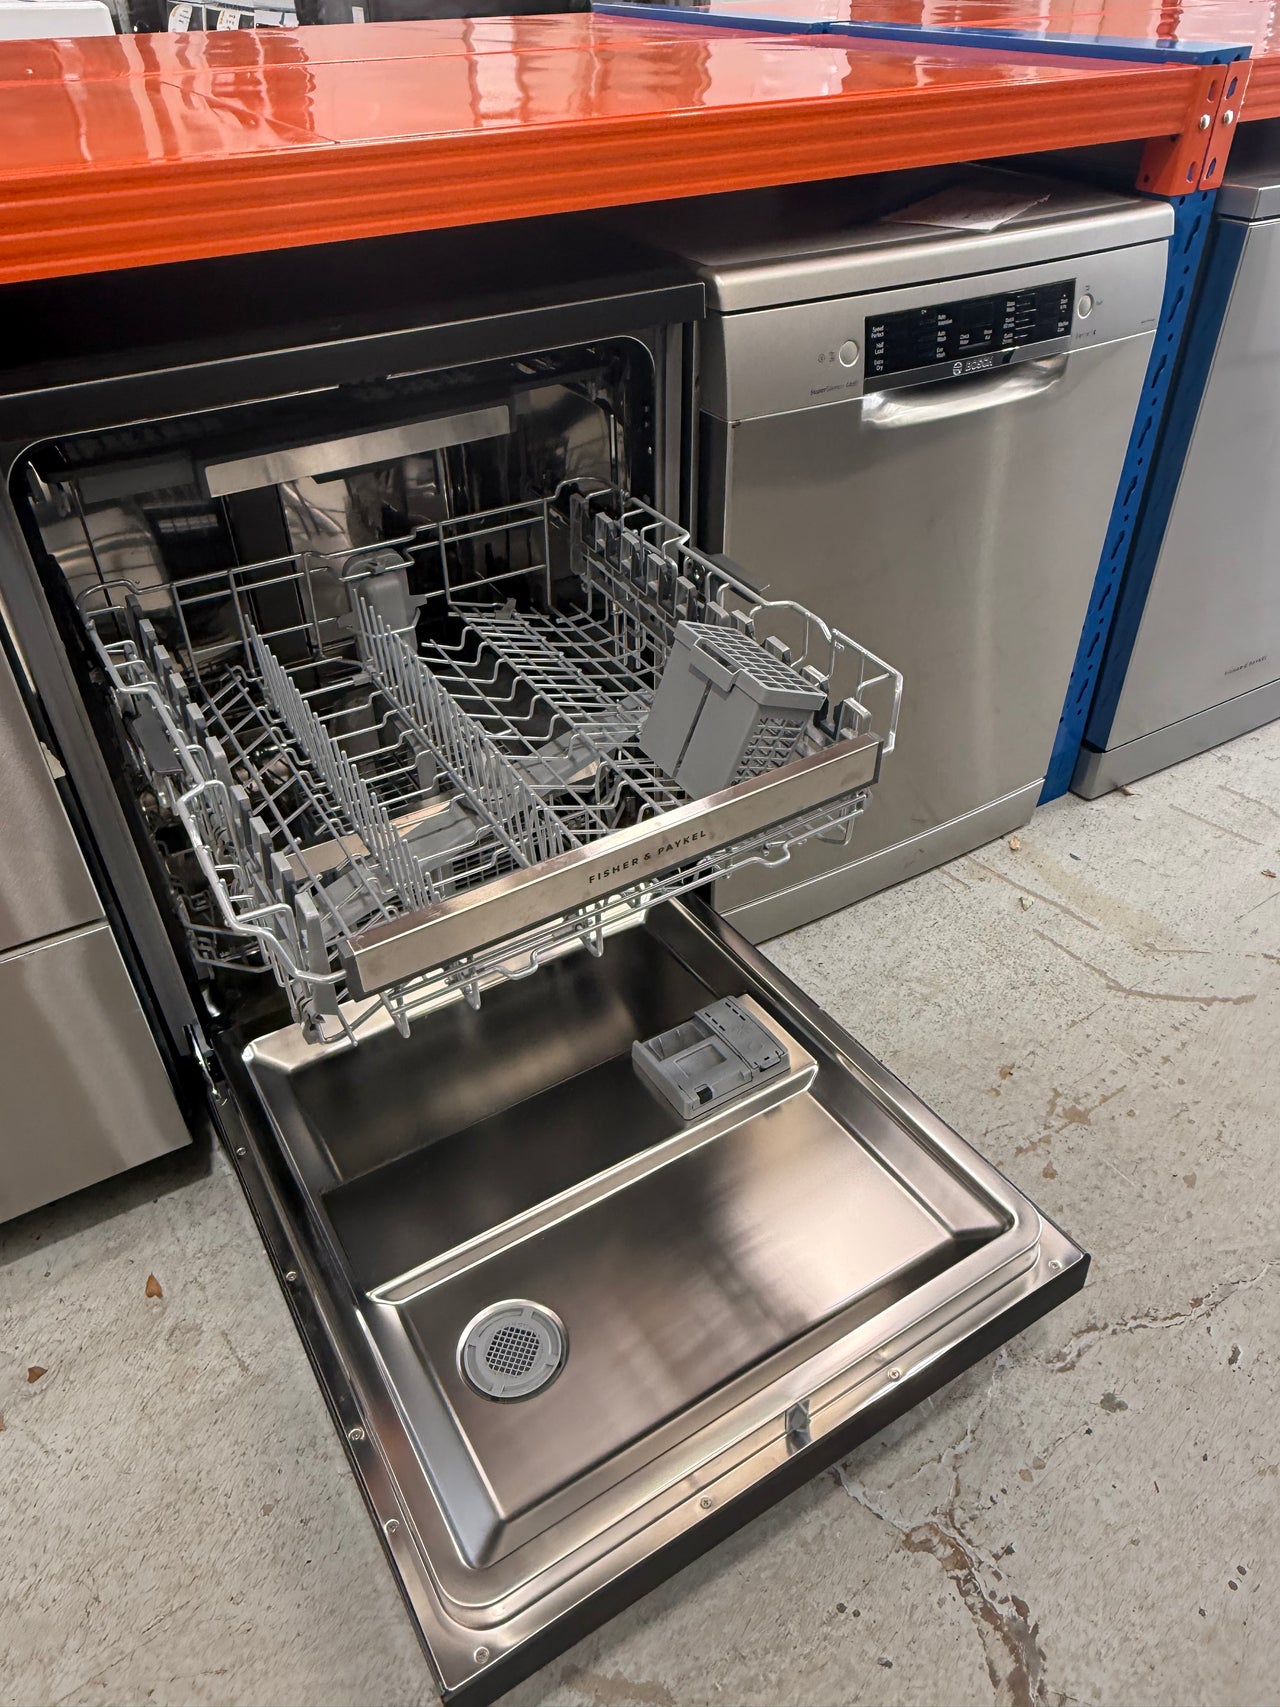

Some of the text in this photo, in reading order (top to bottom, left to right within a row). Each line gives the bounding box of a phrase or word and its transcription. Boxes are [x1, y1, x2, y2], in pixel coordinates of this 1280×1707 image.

[965, 356, 994, 371] BOSCH
[588, 830, 707, 883] FISHER & PAYKEL
